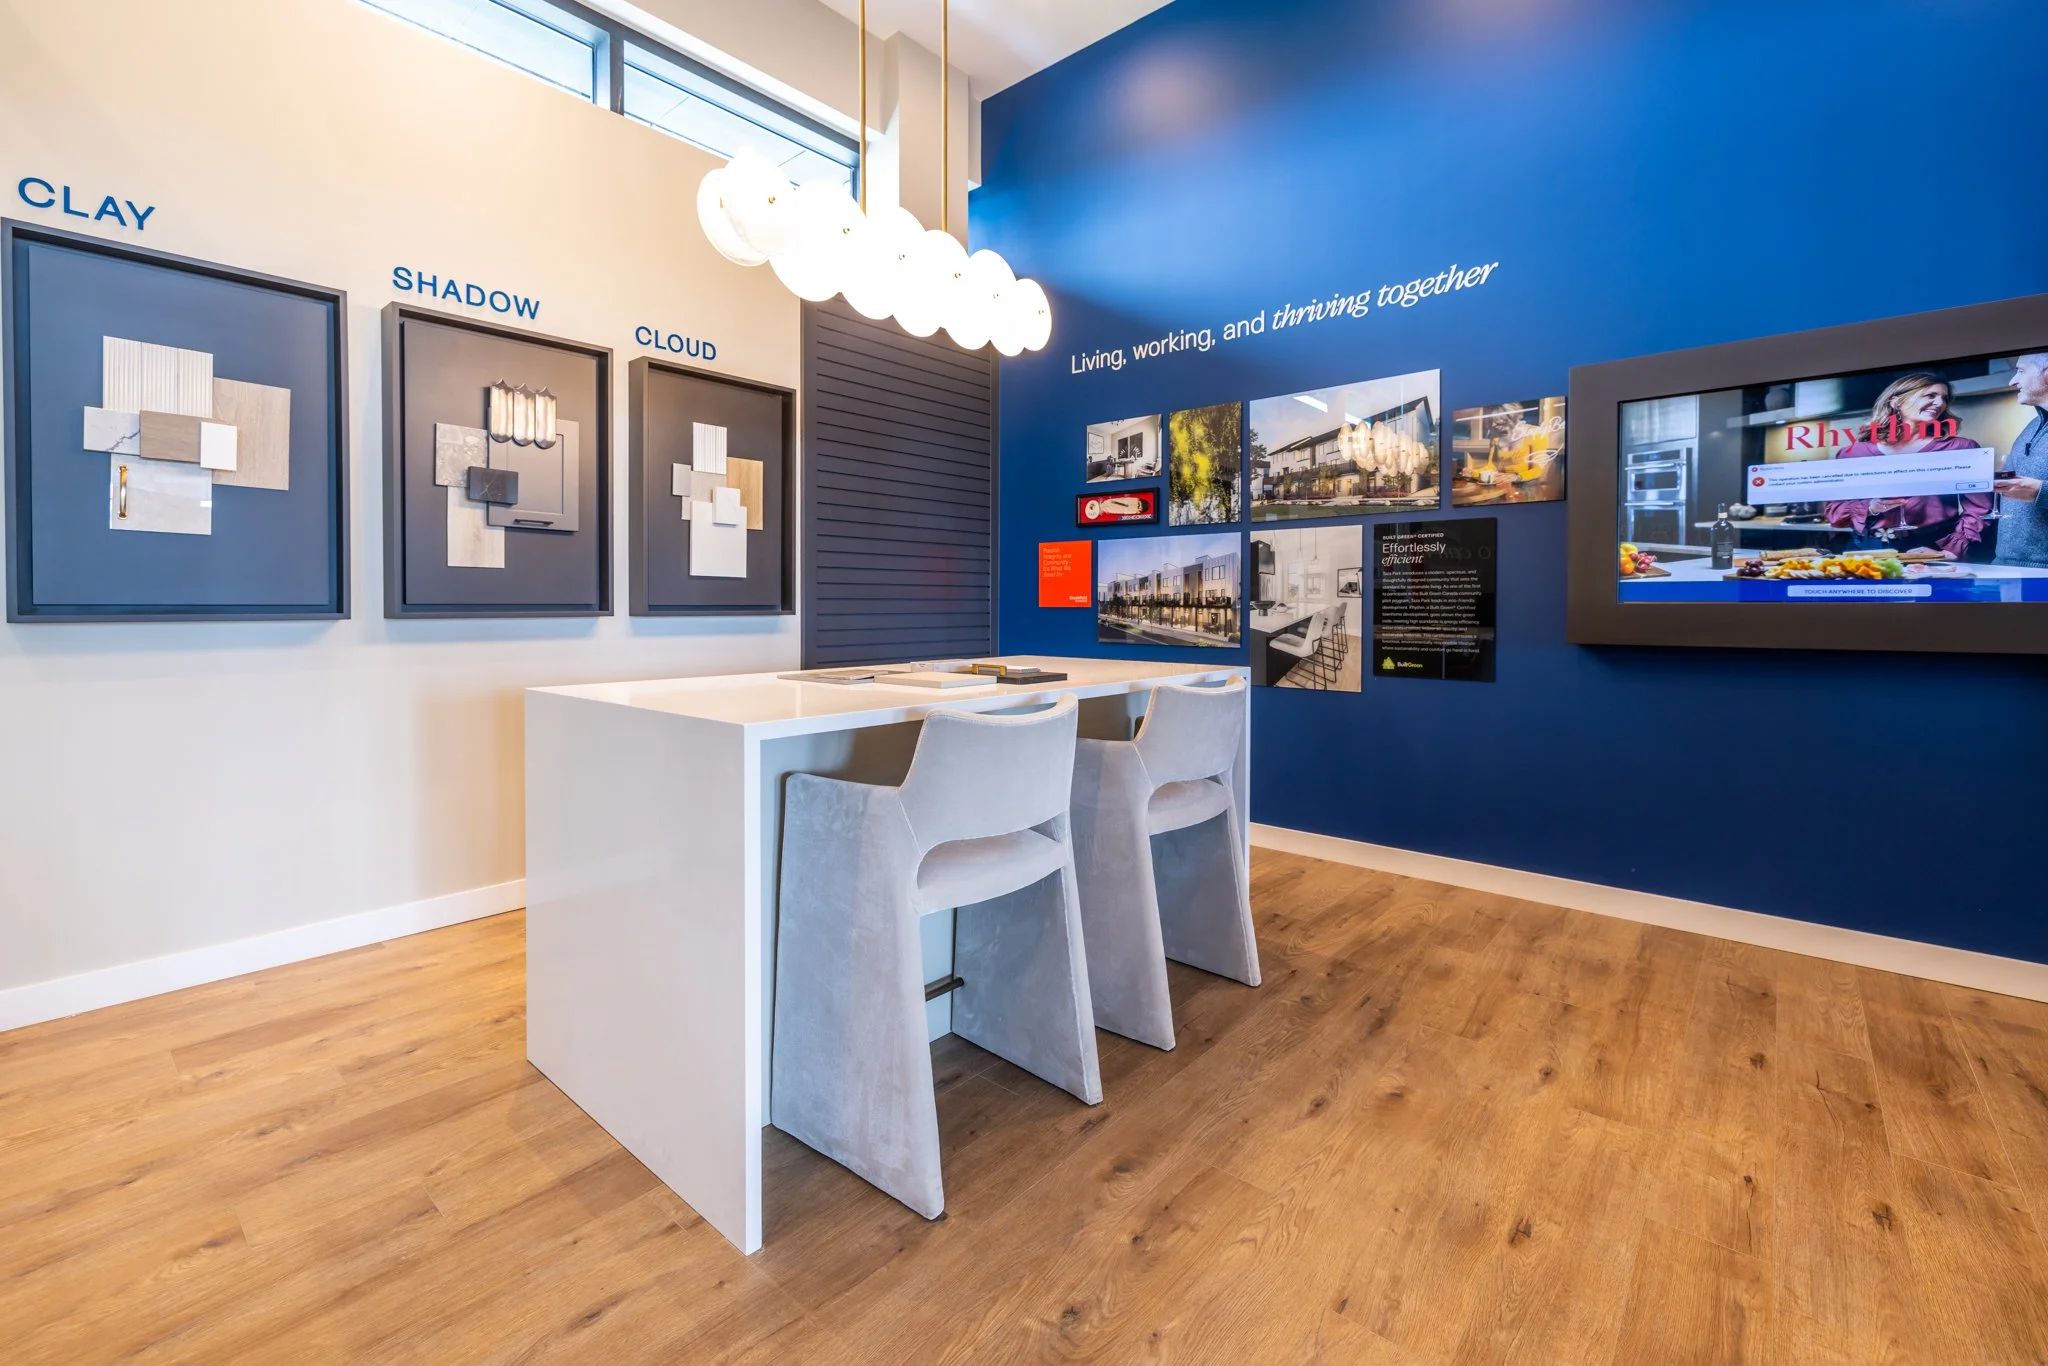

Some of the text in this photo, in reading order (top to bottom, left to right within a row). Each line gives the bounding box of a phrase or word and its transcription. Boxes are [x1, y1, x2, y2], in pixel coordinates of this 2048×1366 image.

[18, 178, 154, 231] CLAY
[393, 267, 539, 320] SHADOW
[1072, 261, 1500, 374] Living, working, and thriving together
[635, 325, 717, 361] CLOUD
[1785, 414, 1958, 453] Rhythm
[1381, 552, 1425, 567] efficient
[1382, 541, 1446, 555] Effortlessly
